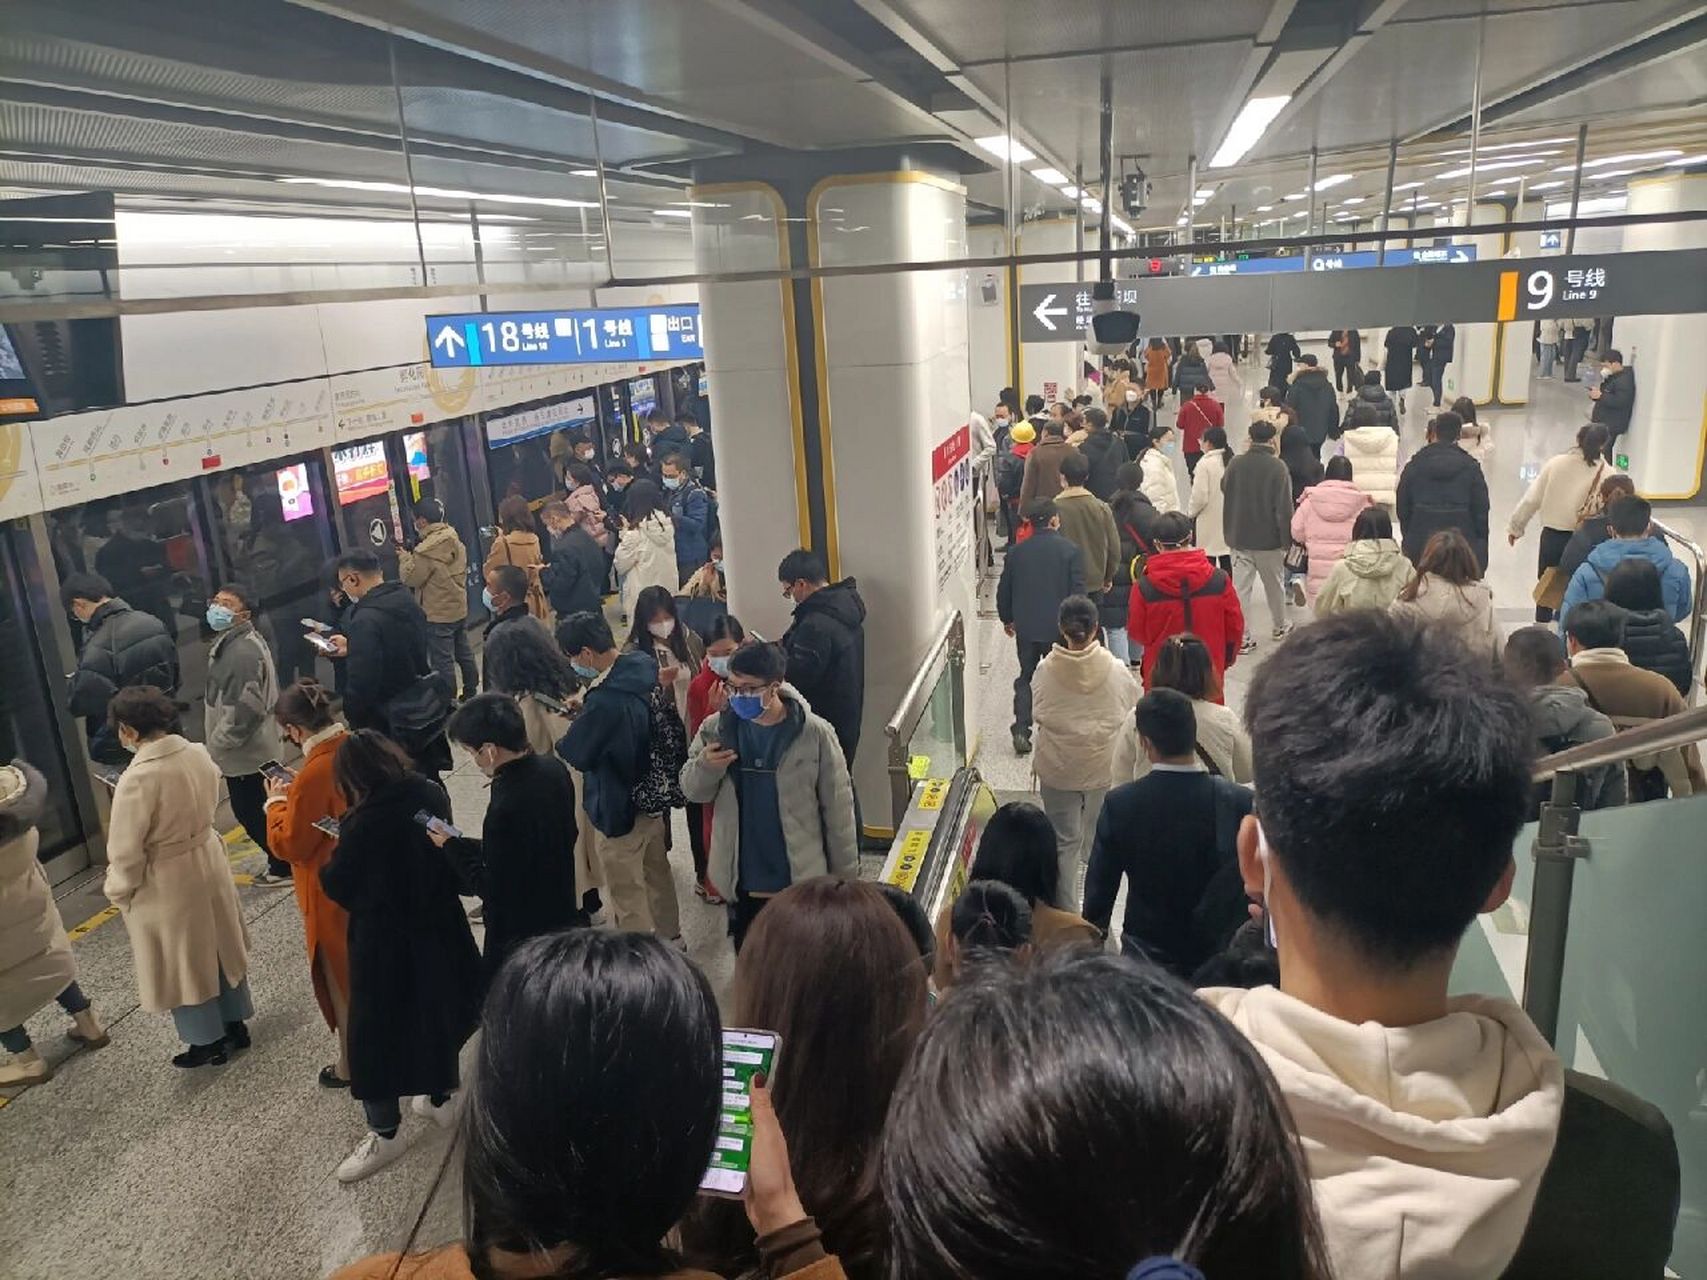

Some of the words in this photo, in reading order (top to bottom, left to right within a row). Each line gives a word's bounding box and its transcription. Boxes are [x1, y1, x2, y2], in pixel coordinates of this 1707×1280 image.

[1527, 270, 1553, 310] 9
[1564, 268, 1605, 288] 号线
[1562, 290, 1587, 301] Line
[1588, 290, 1597, 300] 9
[1076, 290, 1137, 306] 往坝
[667, 315, 693, 332] 出口
[482, 321, 520, 352] 18
[521, 322, 551, 339] 号线
[582, 318, 598, 349] 1
[603, 318, 633, 337] 号线
[522, 342, 538, 352] Line
[538, 342, 548, 351] 18
